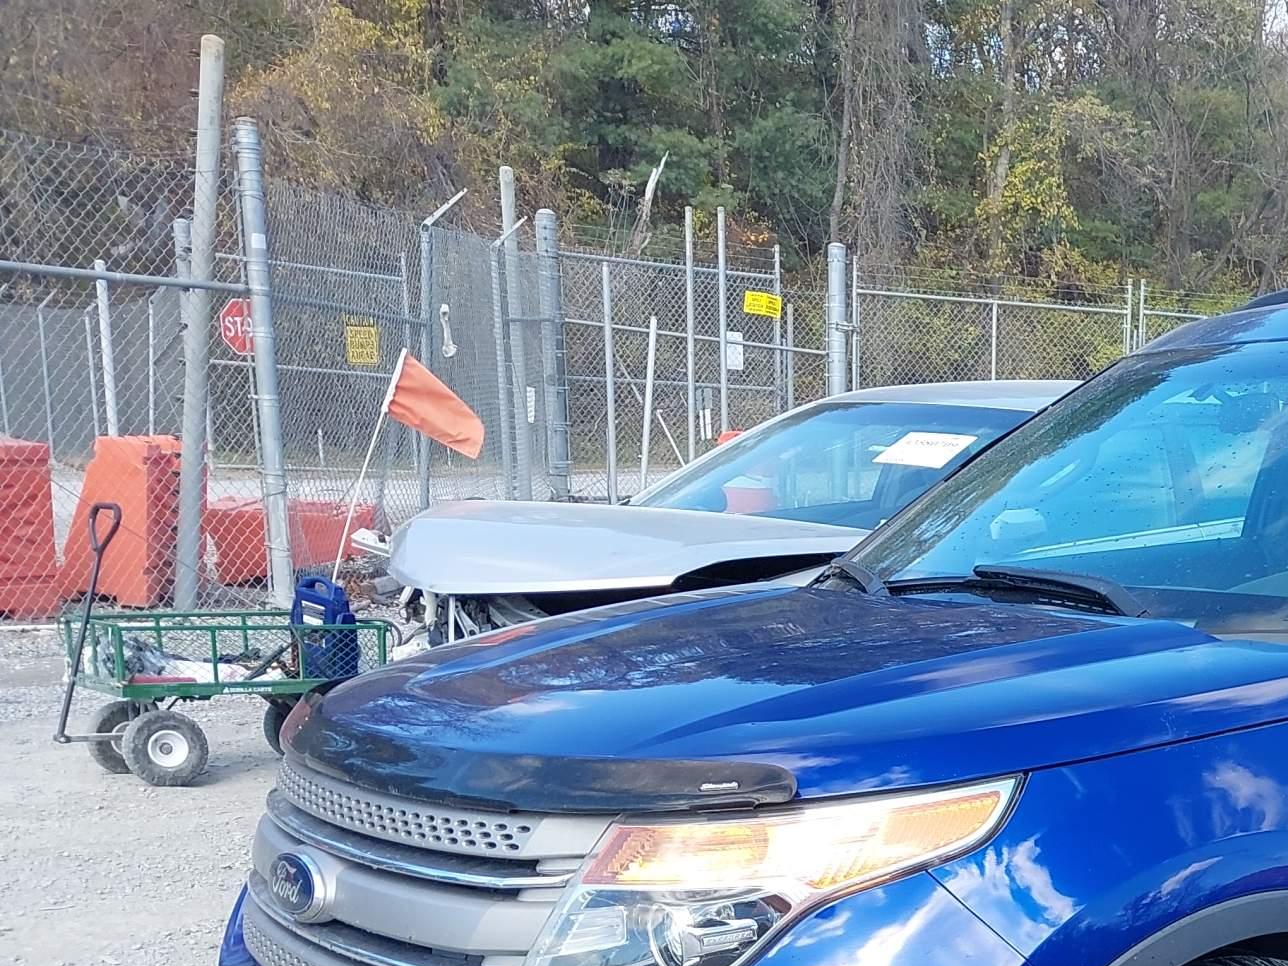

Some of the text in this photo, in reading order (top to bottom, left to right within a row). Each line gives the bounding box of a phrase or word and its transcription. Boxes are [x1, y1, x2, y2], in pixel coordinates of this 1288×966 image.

[224, 315, 253, 337] STO
[350, 328, 374, 339] SPEED
[272, 860, 304, 904] Ford
